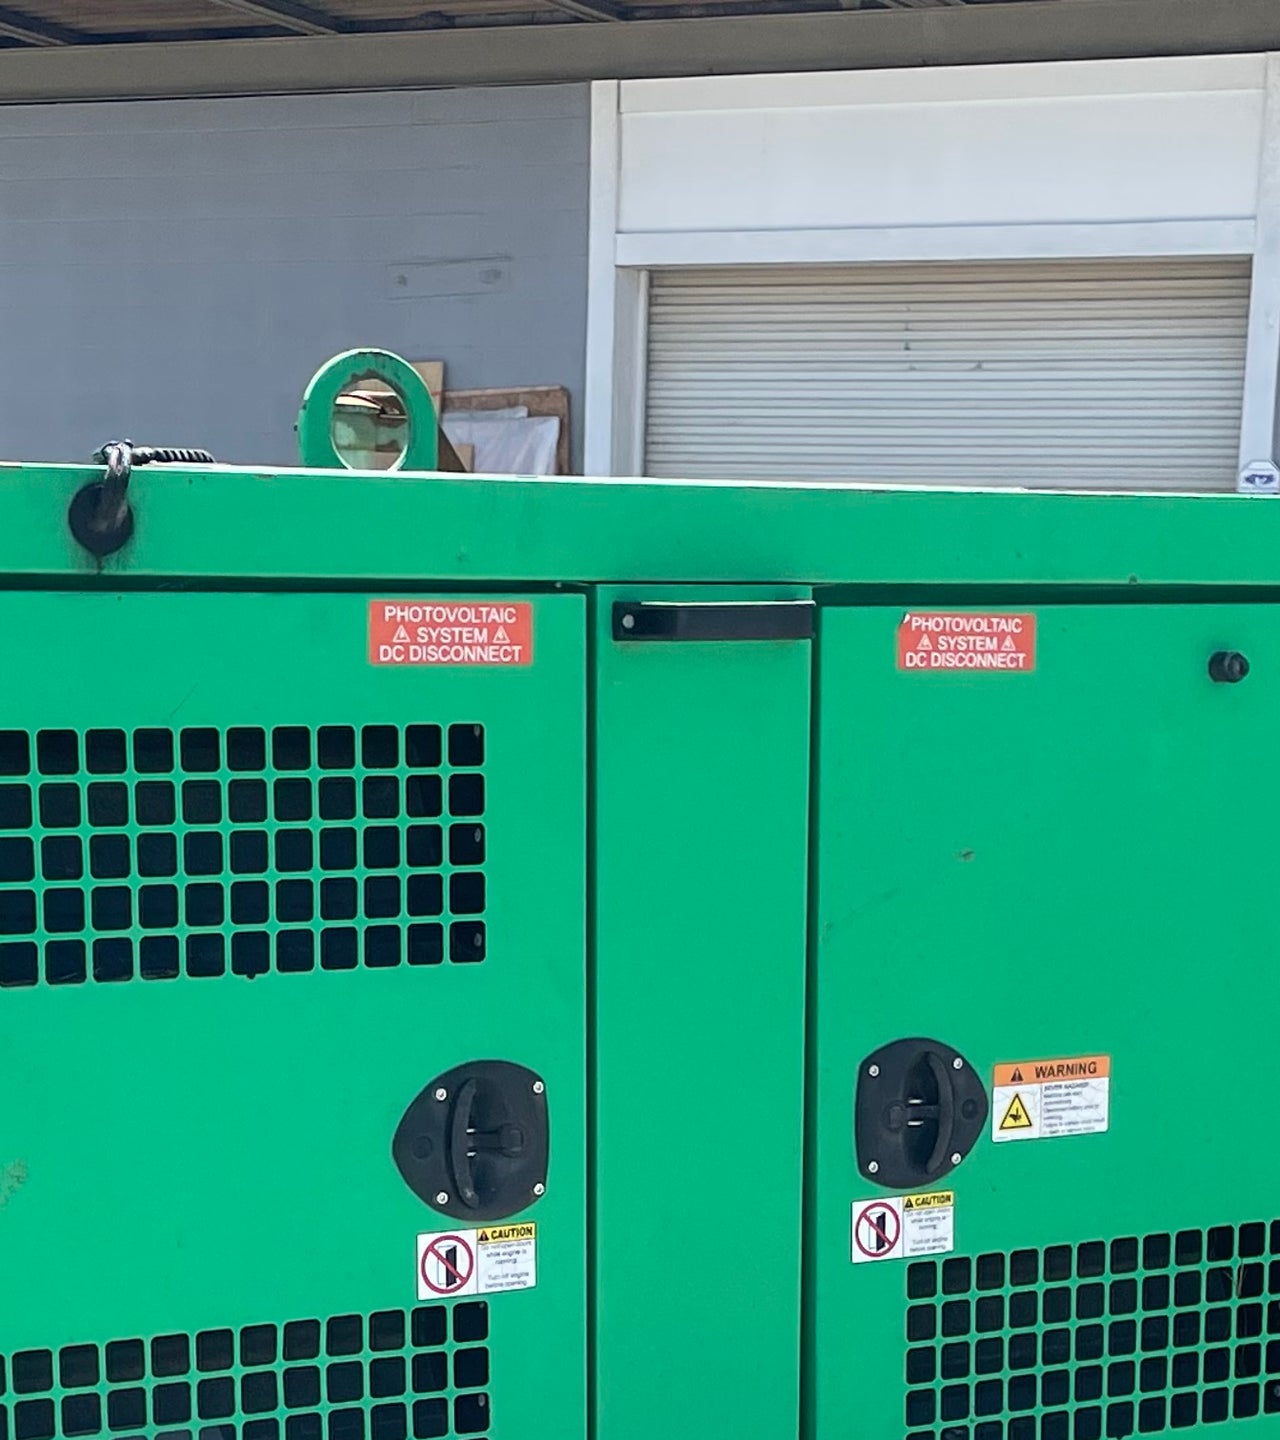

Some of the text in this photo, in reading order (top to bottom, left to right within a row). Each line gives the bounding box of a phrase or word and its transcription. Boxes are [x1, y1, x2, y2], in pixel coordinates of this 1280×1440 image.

[384, 605, 517, 624] PHOTOVOLTAIC
[911, 616, 1023, 633] PHOTOVOLTAIC
[416, 627, 488, 643] SYSTEM
[937, 635, 998, 651] SYSTEM
[379, 645, 522, 662] DC DISCONNECT
[905, 652, 1027, 668] DC DISCONNECT
[1034, 1061, 1098, 1079] WARNING
[915, 1194, 951, 1207] CAUTION
[490, 1226, 533, 1240] CAUTION
